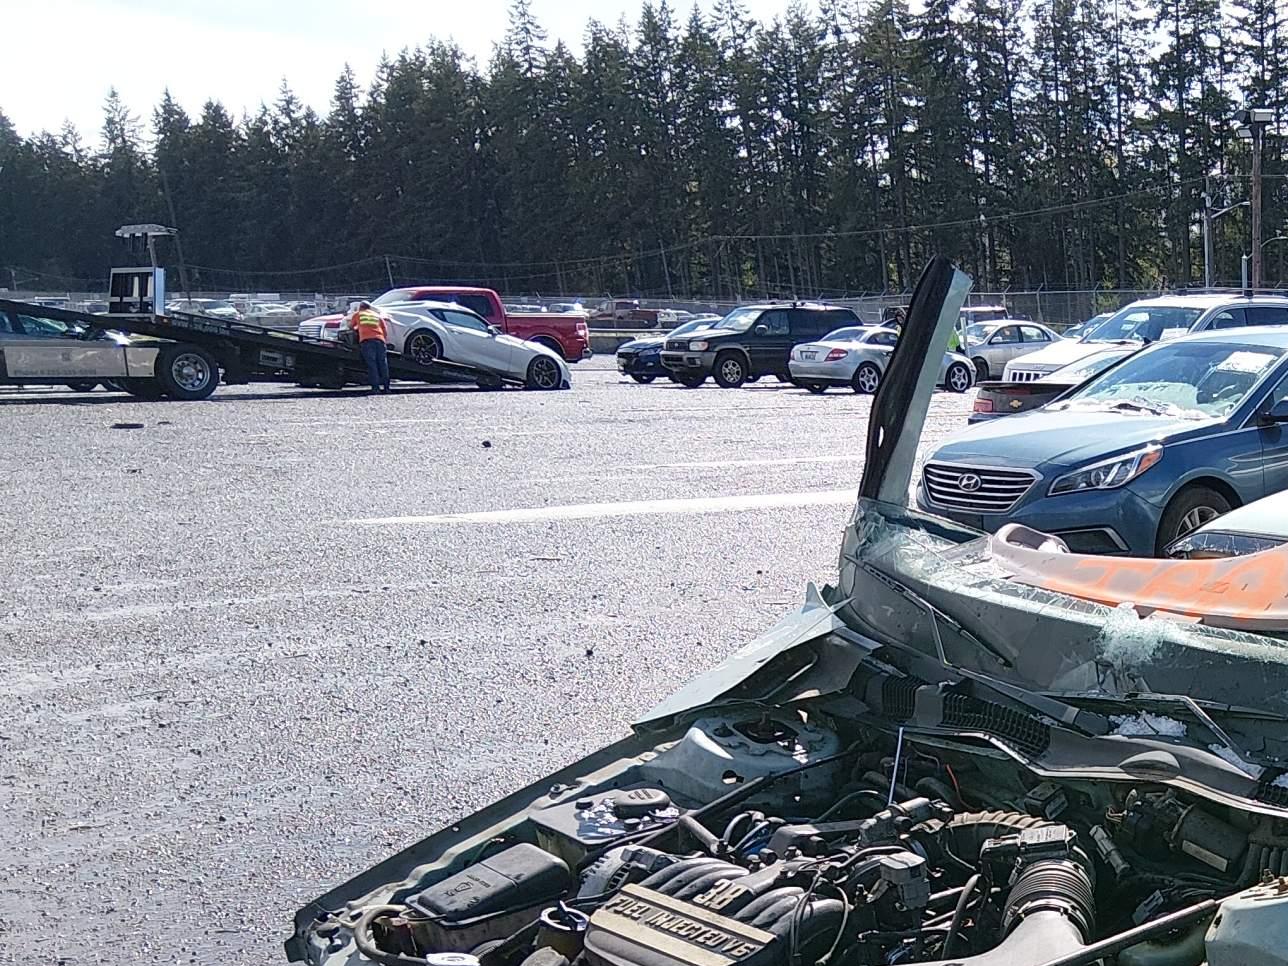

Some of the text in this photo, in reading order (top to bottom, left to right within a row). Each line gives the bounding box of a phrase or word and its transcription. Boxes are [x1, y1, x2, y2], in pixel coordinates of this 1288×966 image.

[692, 878, 746, 911] 3.8
[605, 896, 758, 959] FUEL INJECTED V6
